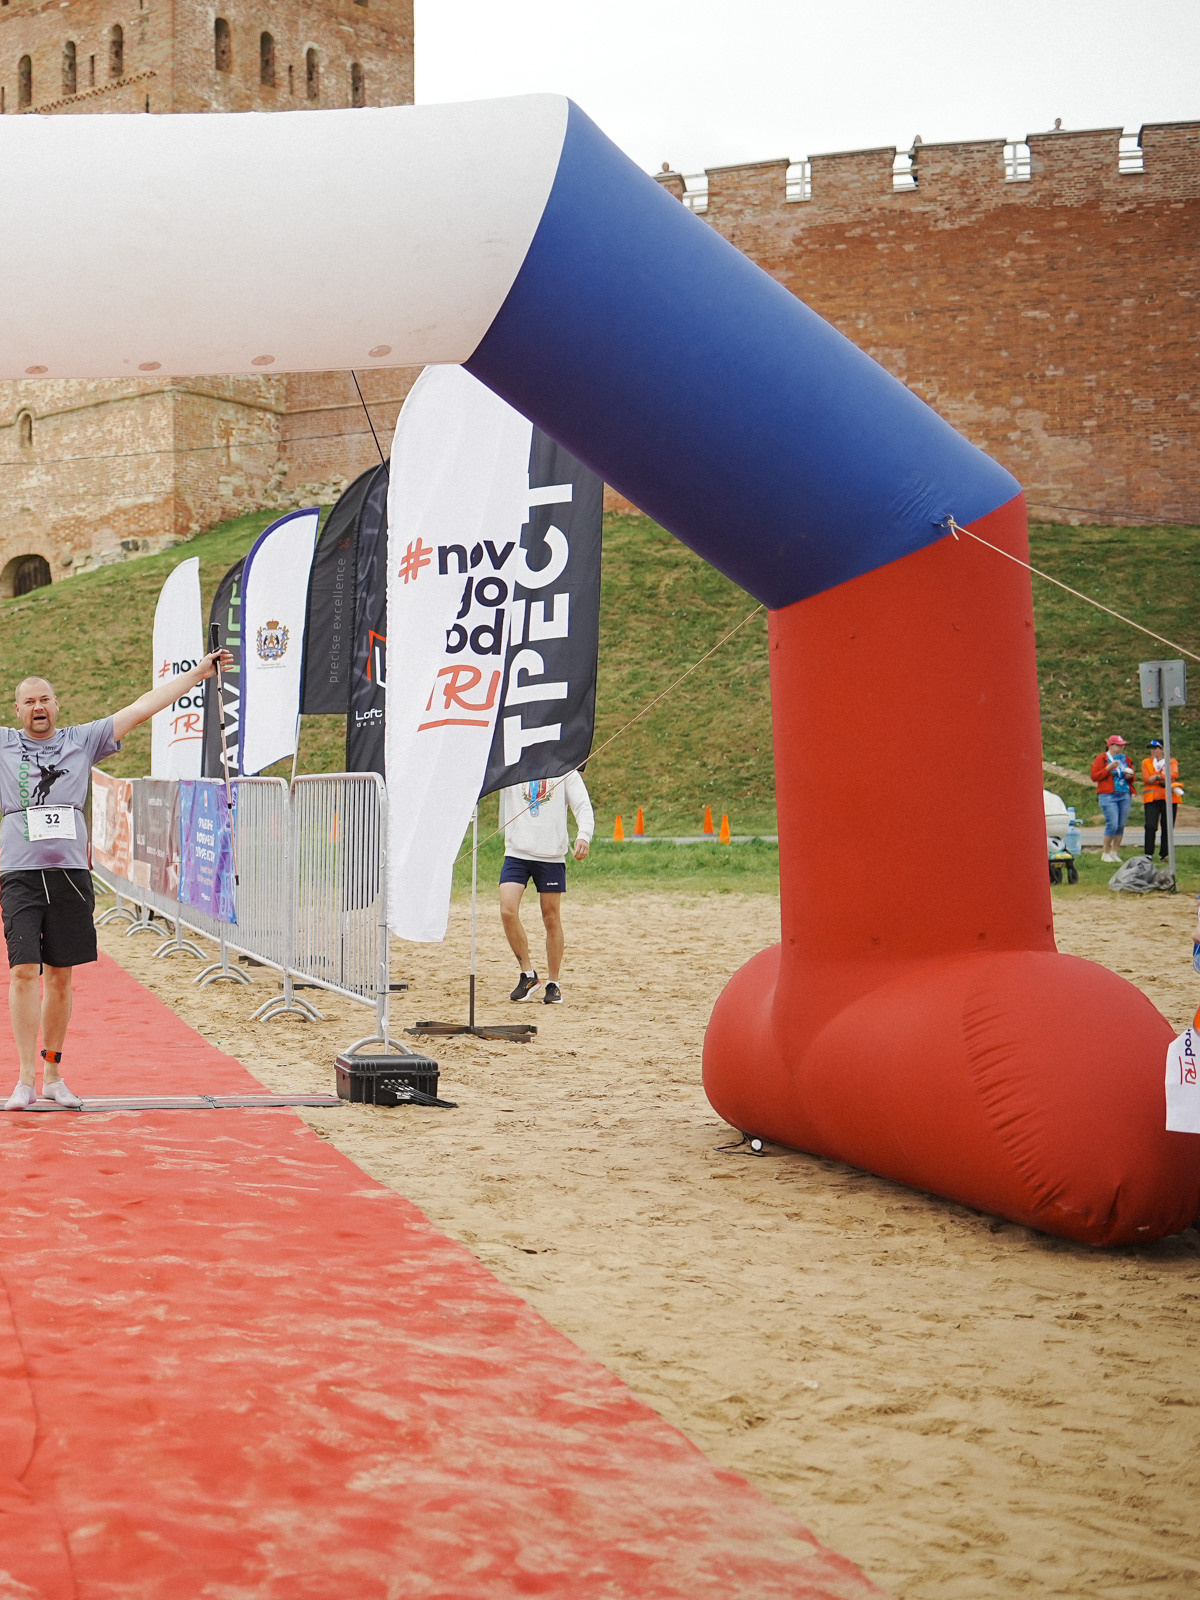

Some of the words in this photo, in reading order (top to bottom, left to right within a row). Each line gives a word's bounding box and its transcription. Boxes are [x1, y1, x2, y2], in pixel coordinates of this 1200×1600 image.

[332, 558, 347, 630] excellence
[329, 634, 341, 684] precise
[355, 708, 383, 721] Loft
[45, 813, 60, 825] 32
